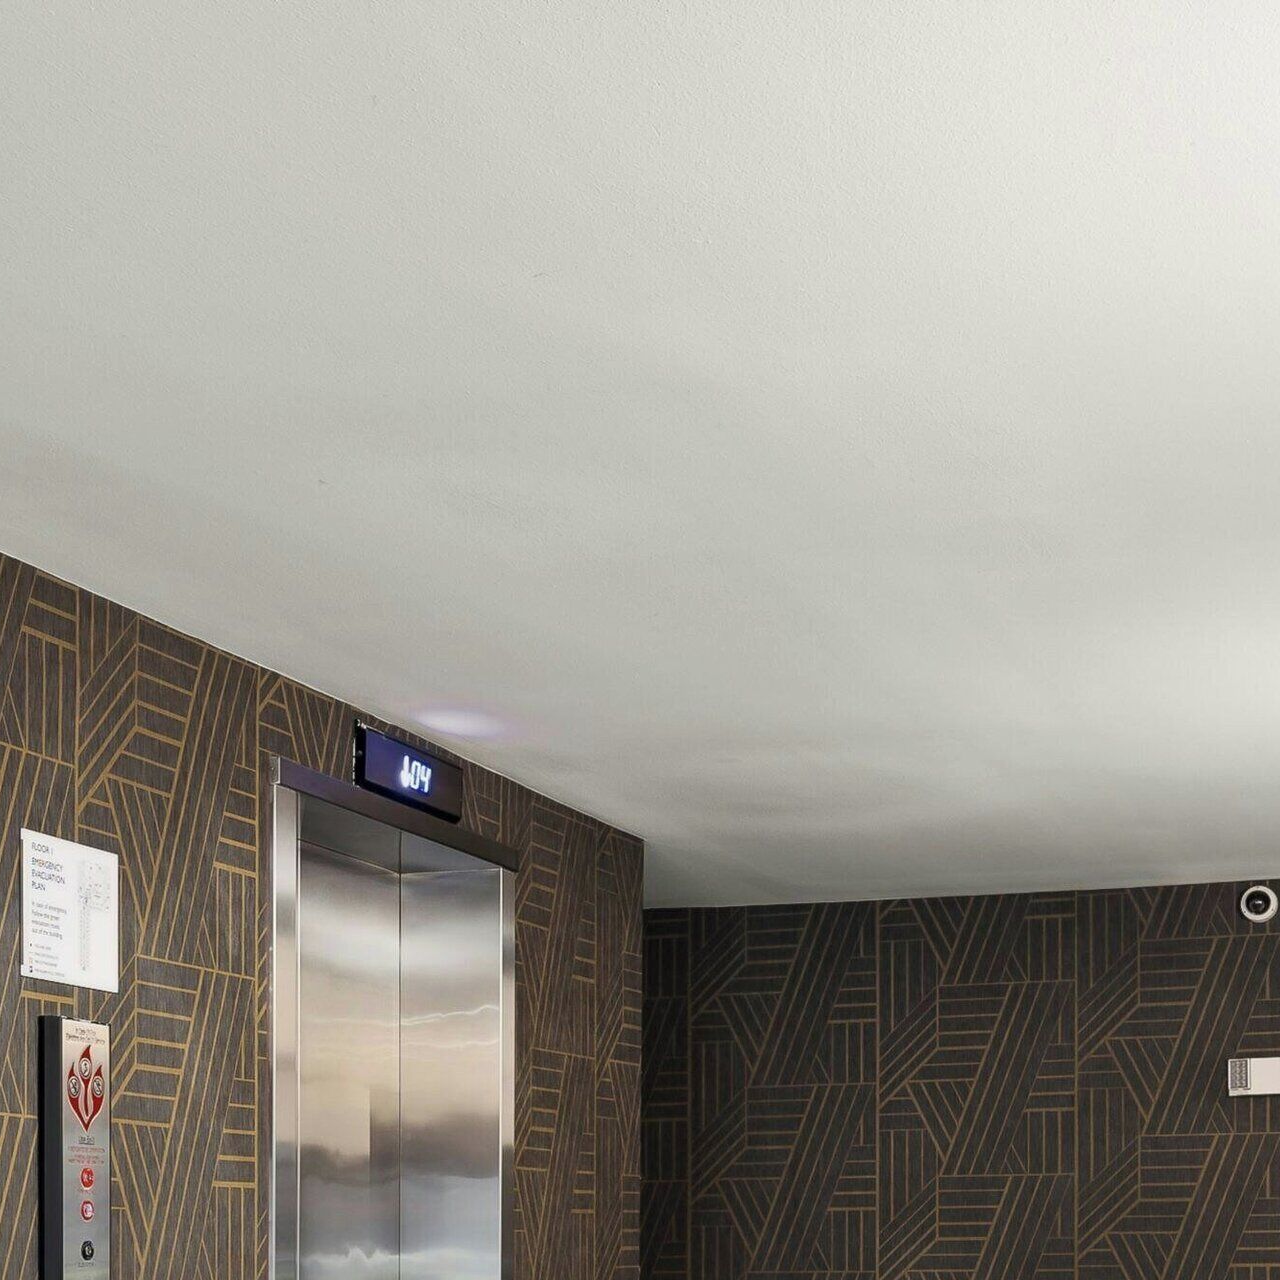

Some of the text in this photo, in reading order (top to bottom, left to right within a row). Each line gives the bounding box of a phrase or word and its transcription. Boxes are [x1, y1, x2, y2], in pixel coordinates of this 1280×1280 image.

[409, 759, 432, 793] 04
[31, 841, 49, 853] FLOOR
[31, 857, 63, 872] EMERGENCY
[31, 868, 65, 885] EVACUATION
[31, 880, 46, 891] PLAN
